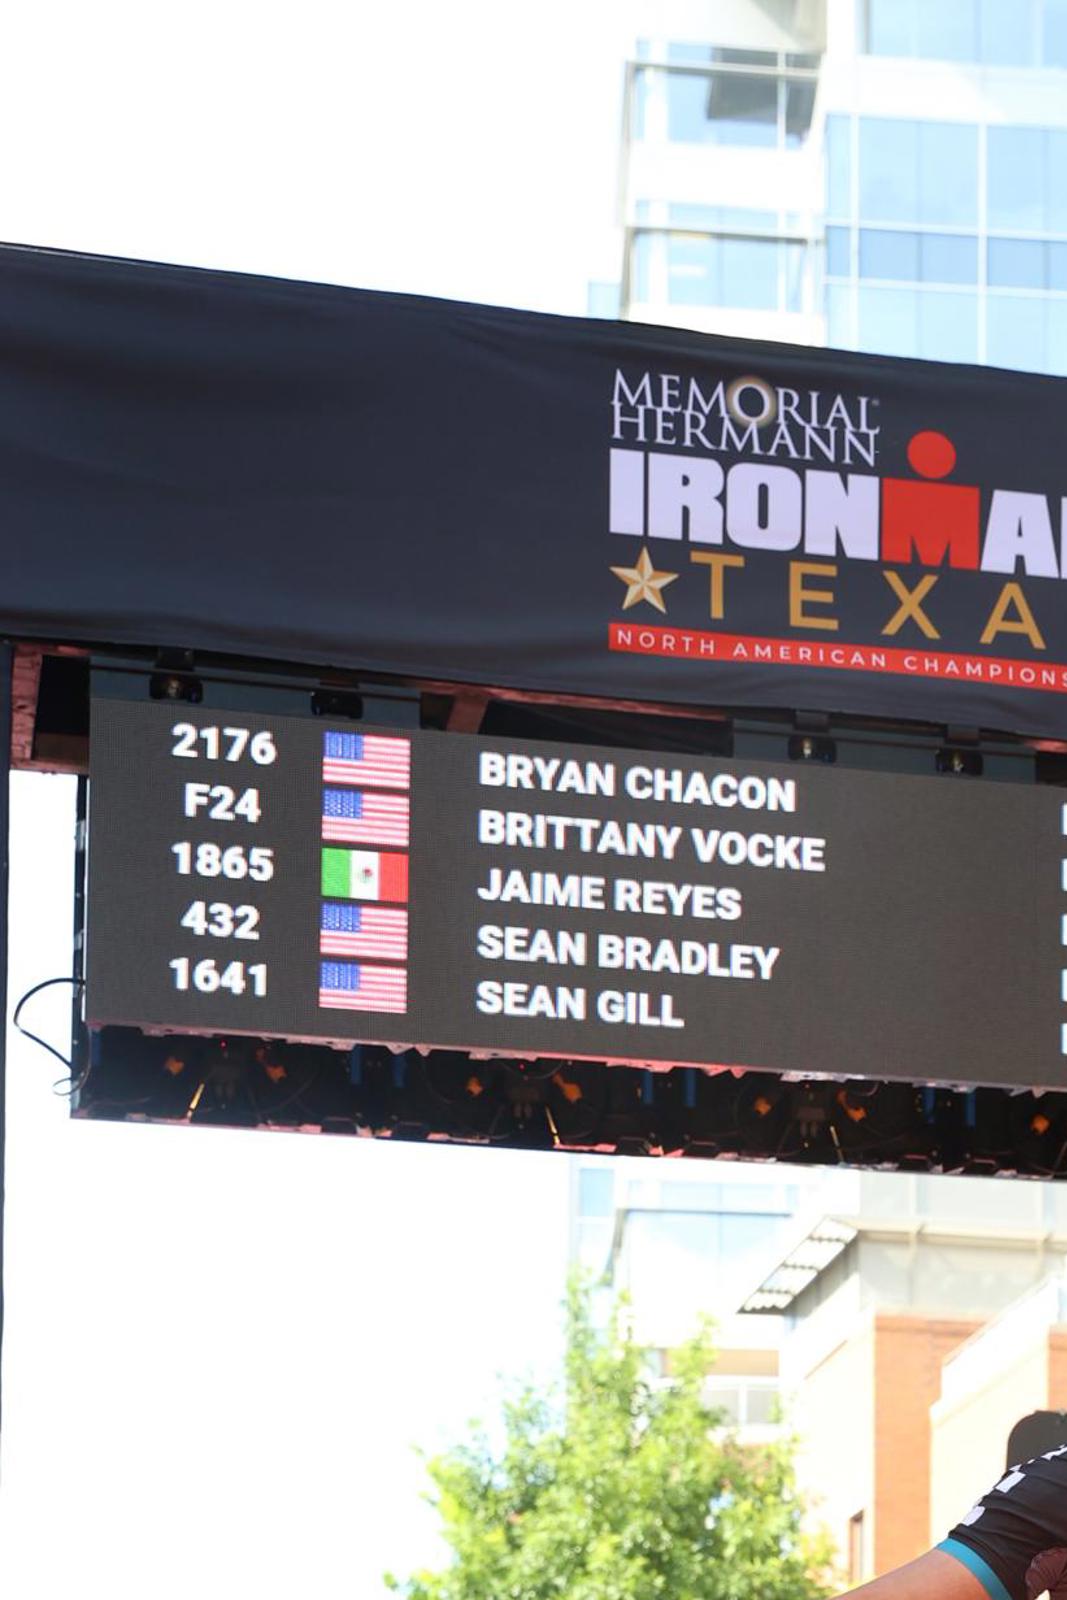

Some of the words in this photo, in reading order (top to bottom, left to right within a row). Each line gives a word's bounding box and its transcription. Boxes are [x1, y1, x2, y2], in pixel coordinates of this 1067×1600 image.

[611, 369, 880, 434] MEMORIAL
[611, 402, 878, 466] HERMANN
[617, 630, 716, 656] NORTH
[733, 641, 887, 668] AMERICAN
[171, 722, 277, 765] 2176
[478, 752, 616, 798] BRYAN
[625, 765, 796, 813] CHACON
[185, 782, 261, 824] F24
[478, 810, 684, 856] BRITTANY
[692, 826, 826, 873] VOCKE
[172, 841, 274, 882] 1865
[476, 868, 604, 911] JAIME
[615, 879, 742, 921] REYES
[180, 900, 259, 941] 432
[476, 926, 586, 966] SEAN
[598, 933, 779, 980] BRADLEY
[169, 957, 267, 997] 1641
[476, 982, 586, 1020] SEAN
[597, 990, 684, 1028] GILL
